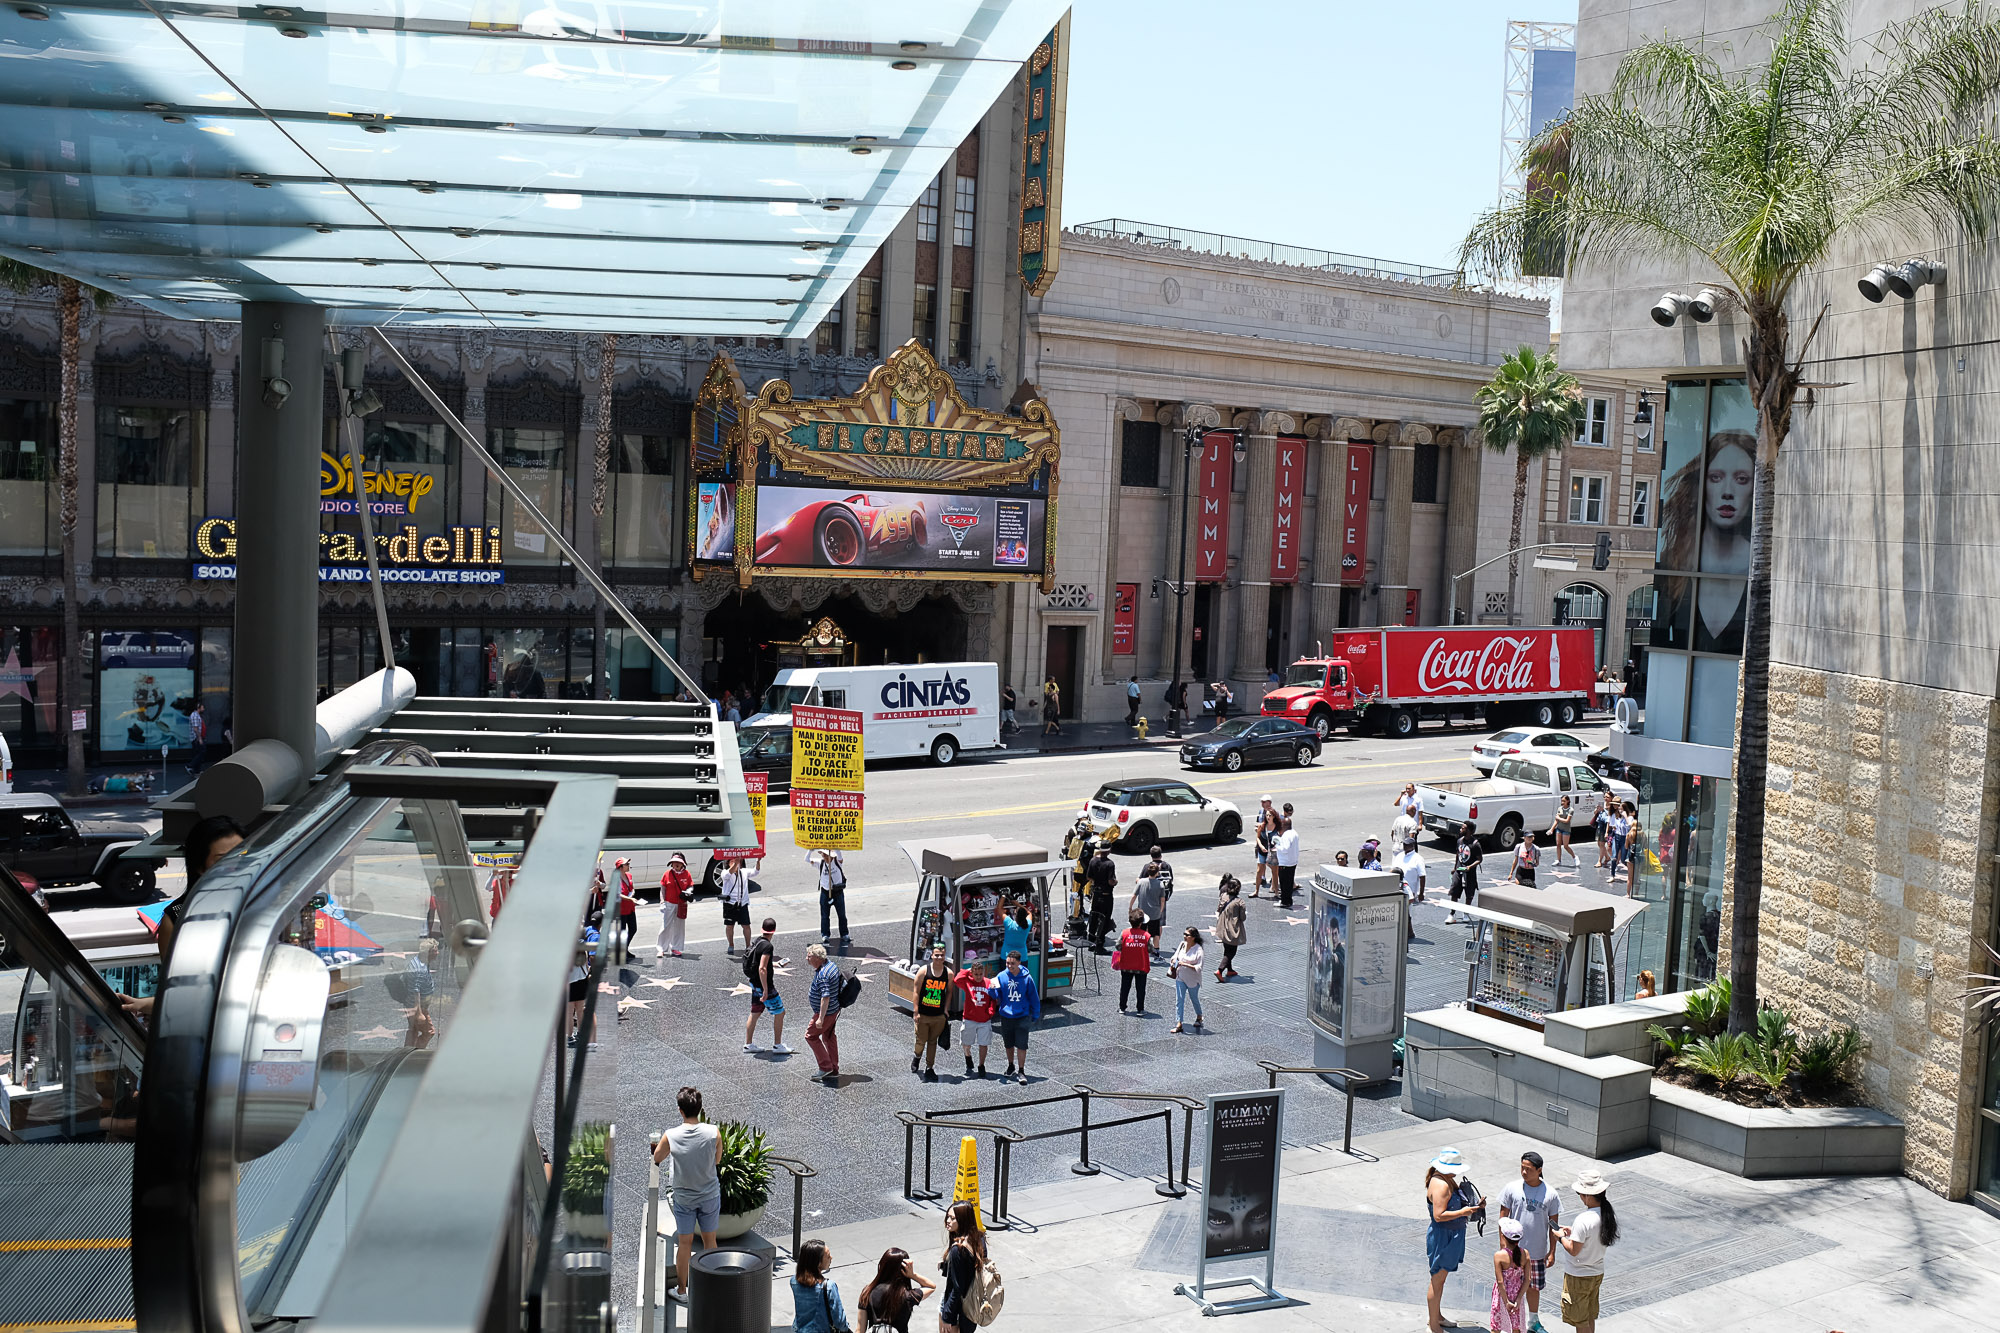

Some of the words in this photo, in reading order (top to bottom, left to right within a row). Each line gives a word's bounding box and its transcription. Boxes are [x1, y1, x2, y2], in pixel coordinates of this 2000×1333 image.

[1215, 282, 1290, 299] FREEMASONRY
[1300, 294, 1337, 306] BUILDS
[1222, 305, 1245, 316] AND
[1256, 309, 1269, 319] IN
[1279, 312, 1300, 323] THE
[1251, 298, 1289, 310] AMONG
[1300, 303, 1319, 314] THE
[1329, 307, 1375, 322] NATIONS
[817, 424, 854, 450] EL
[863, 427, 1005, 460] CAPITAN
[1204, 445, 1219, 567] JIMMY
[1346, 455, 1359, 544] LIVE
[1277, 450, 1293, 569] KIMMEL
[945, 515, 974, 525] Cars
[955, 531, 964, 540] 3
[1342, 557, 1358, 567] abc
[328, 568, 364, 580] AND
[460, 570, 501, 583] SHOP
[1418, 636, 1537, 692] Coca-Cola
[796, 717, 827, 729] HEAVEN
[841, 721, 860, 732] HELL
[800, 740, 811, 749] TO
[815, 742, 828, 751] DIE
[817, 733, 823, 741] IS
[825, 734, 858, 744] DESTINED
[818, 751, 836, 759] AFTER
[809, 758, 821, 767] TO
[825, 760, 847, 768] FACE
[796, 798, 812, 807] SIN
[815, 799, 824, 807] IS
[807, 816, 839, 825] ETERNAL
[841, 817, 856, 825] LIFE
[808, 824, 833, 832] CHRIST
[1314, 871, 1352, 896] DIRECTORY
[1355, 904, 1396, 917] Hollywood
[925, 979, 947, 990] SAN
[1216, 1104, 1273, 1121] MUMMY
